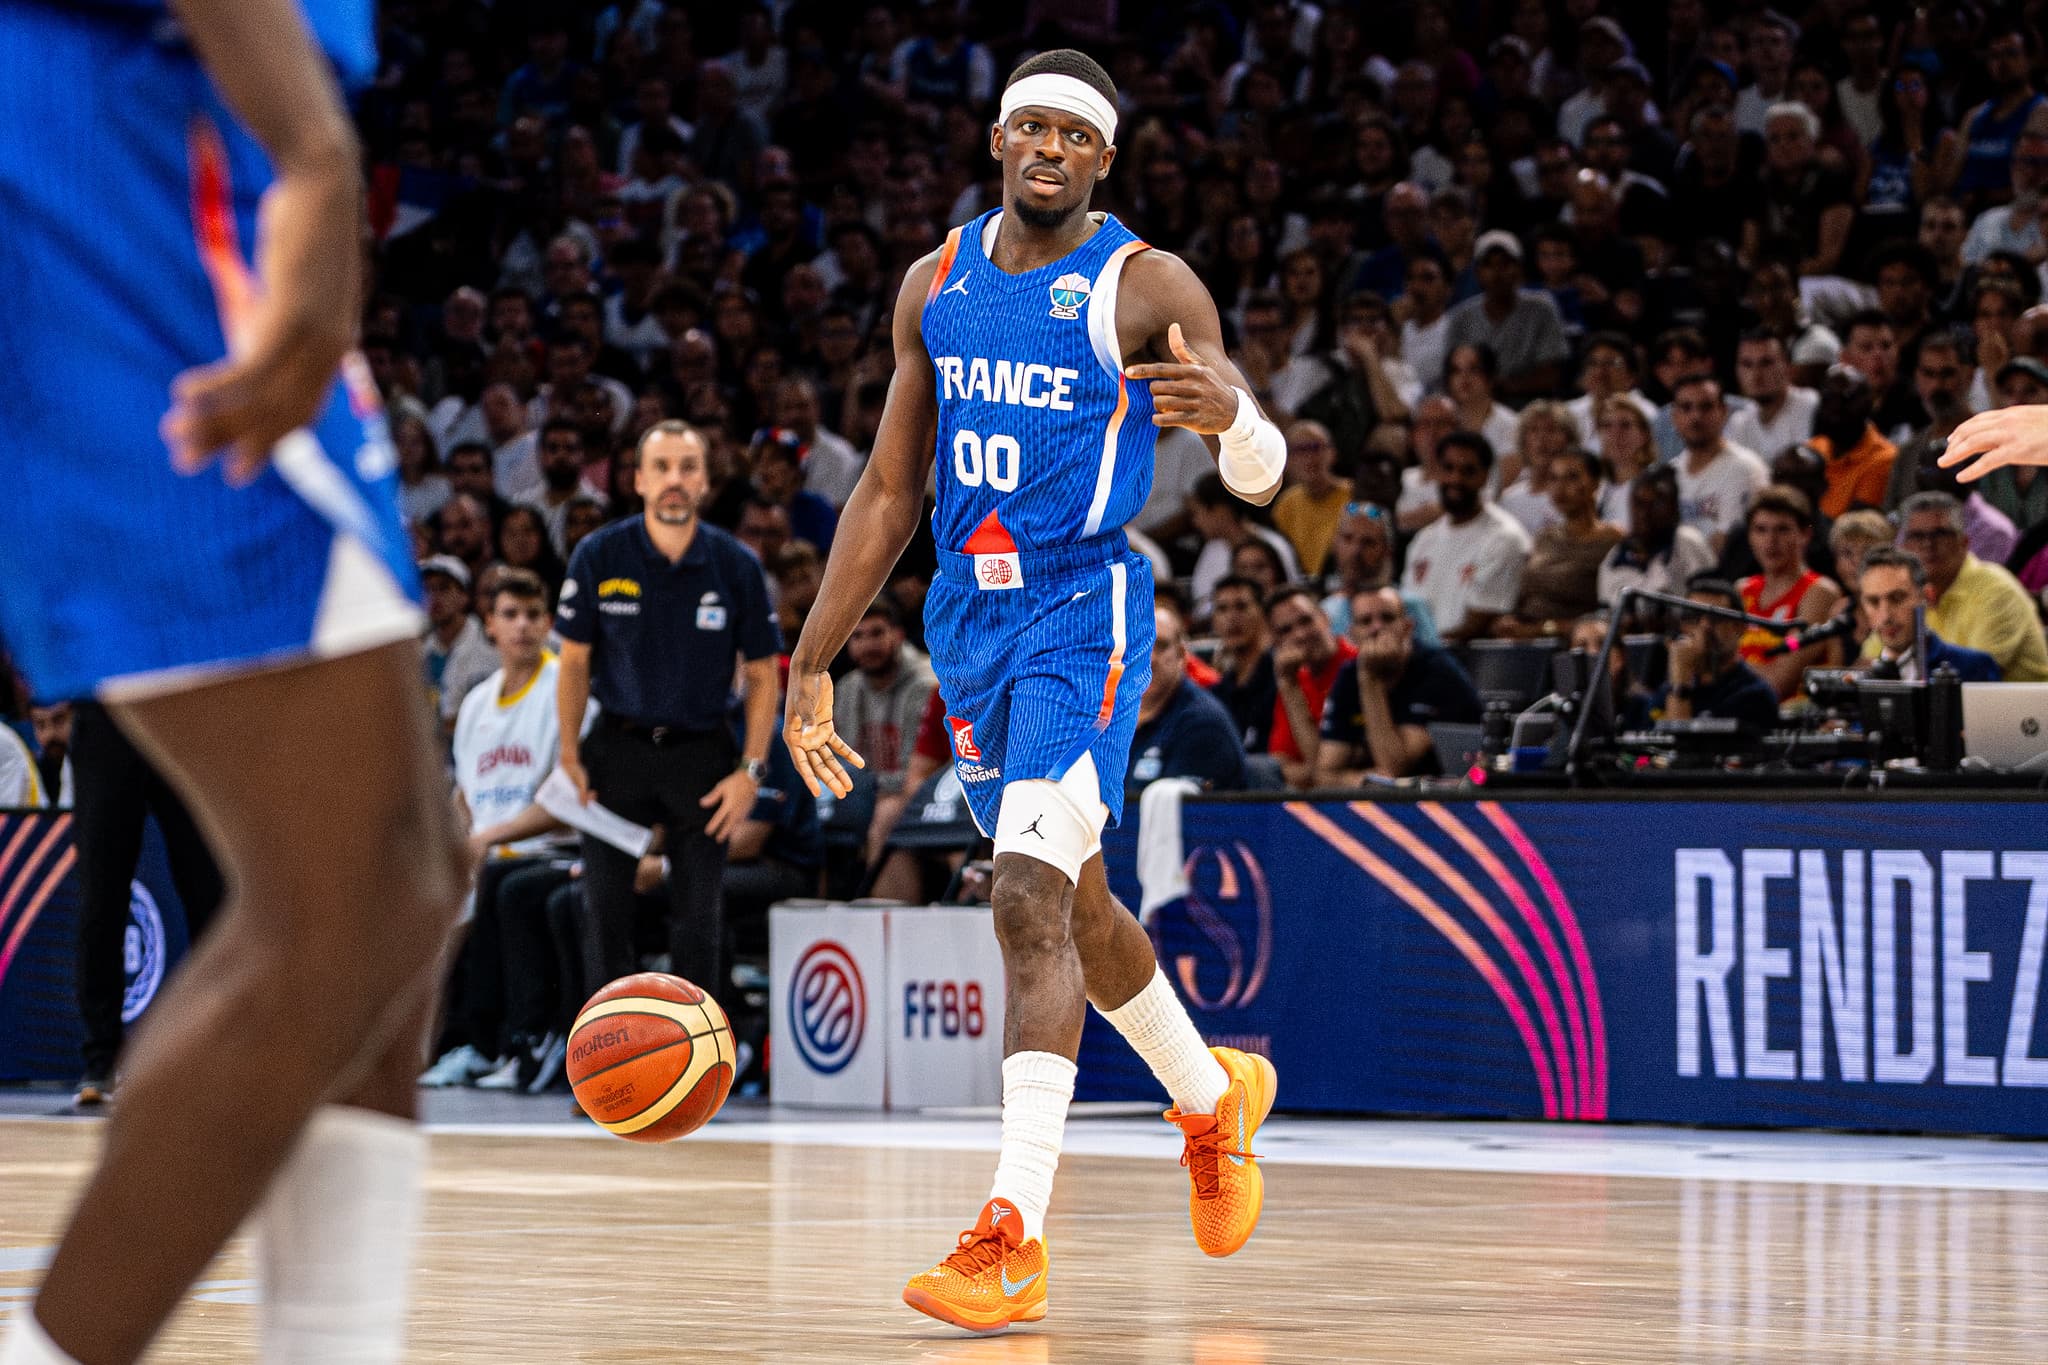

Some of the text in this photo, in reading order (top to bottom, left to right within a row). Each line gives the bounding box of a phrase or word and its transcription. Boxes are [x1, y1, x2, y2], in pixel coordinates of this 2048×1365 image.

[953, 429, 1021, 493] 00
[904, 979, 986, 1040] FFBB
[572, 1028, 630, 1064] molten
